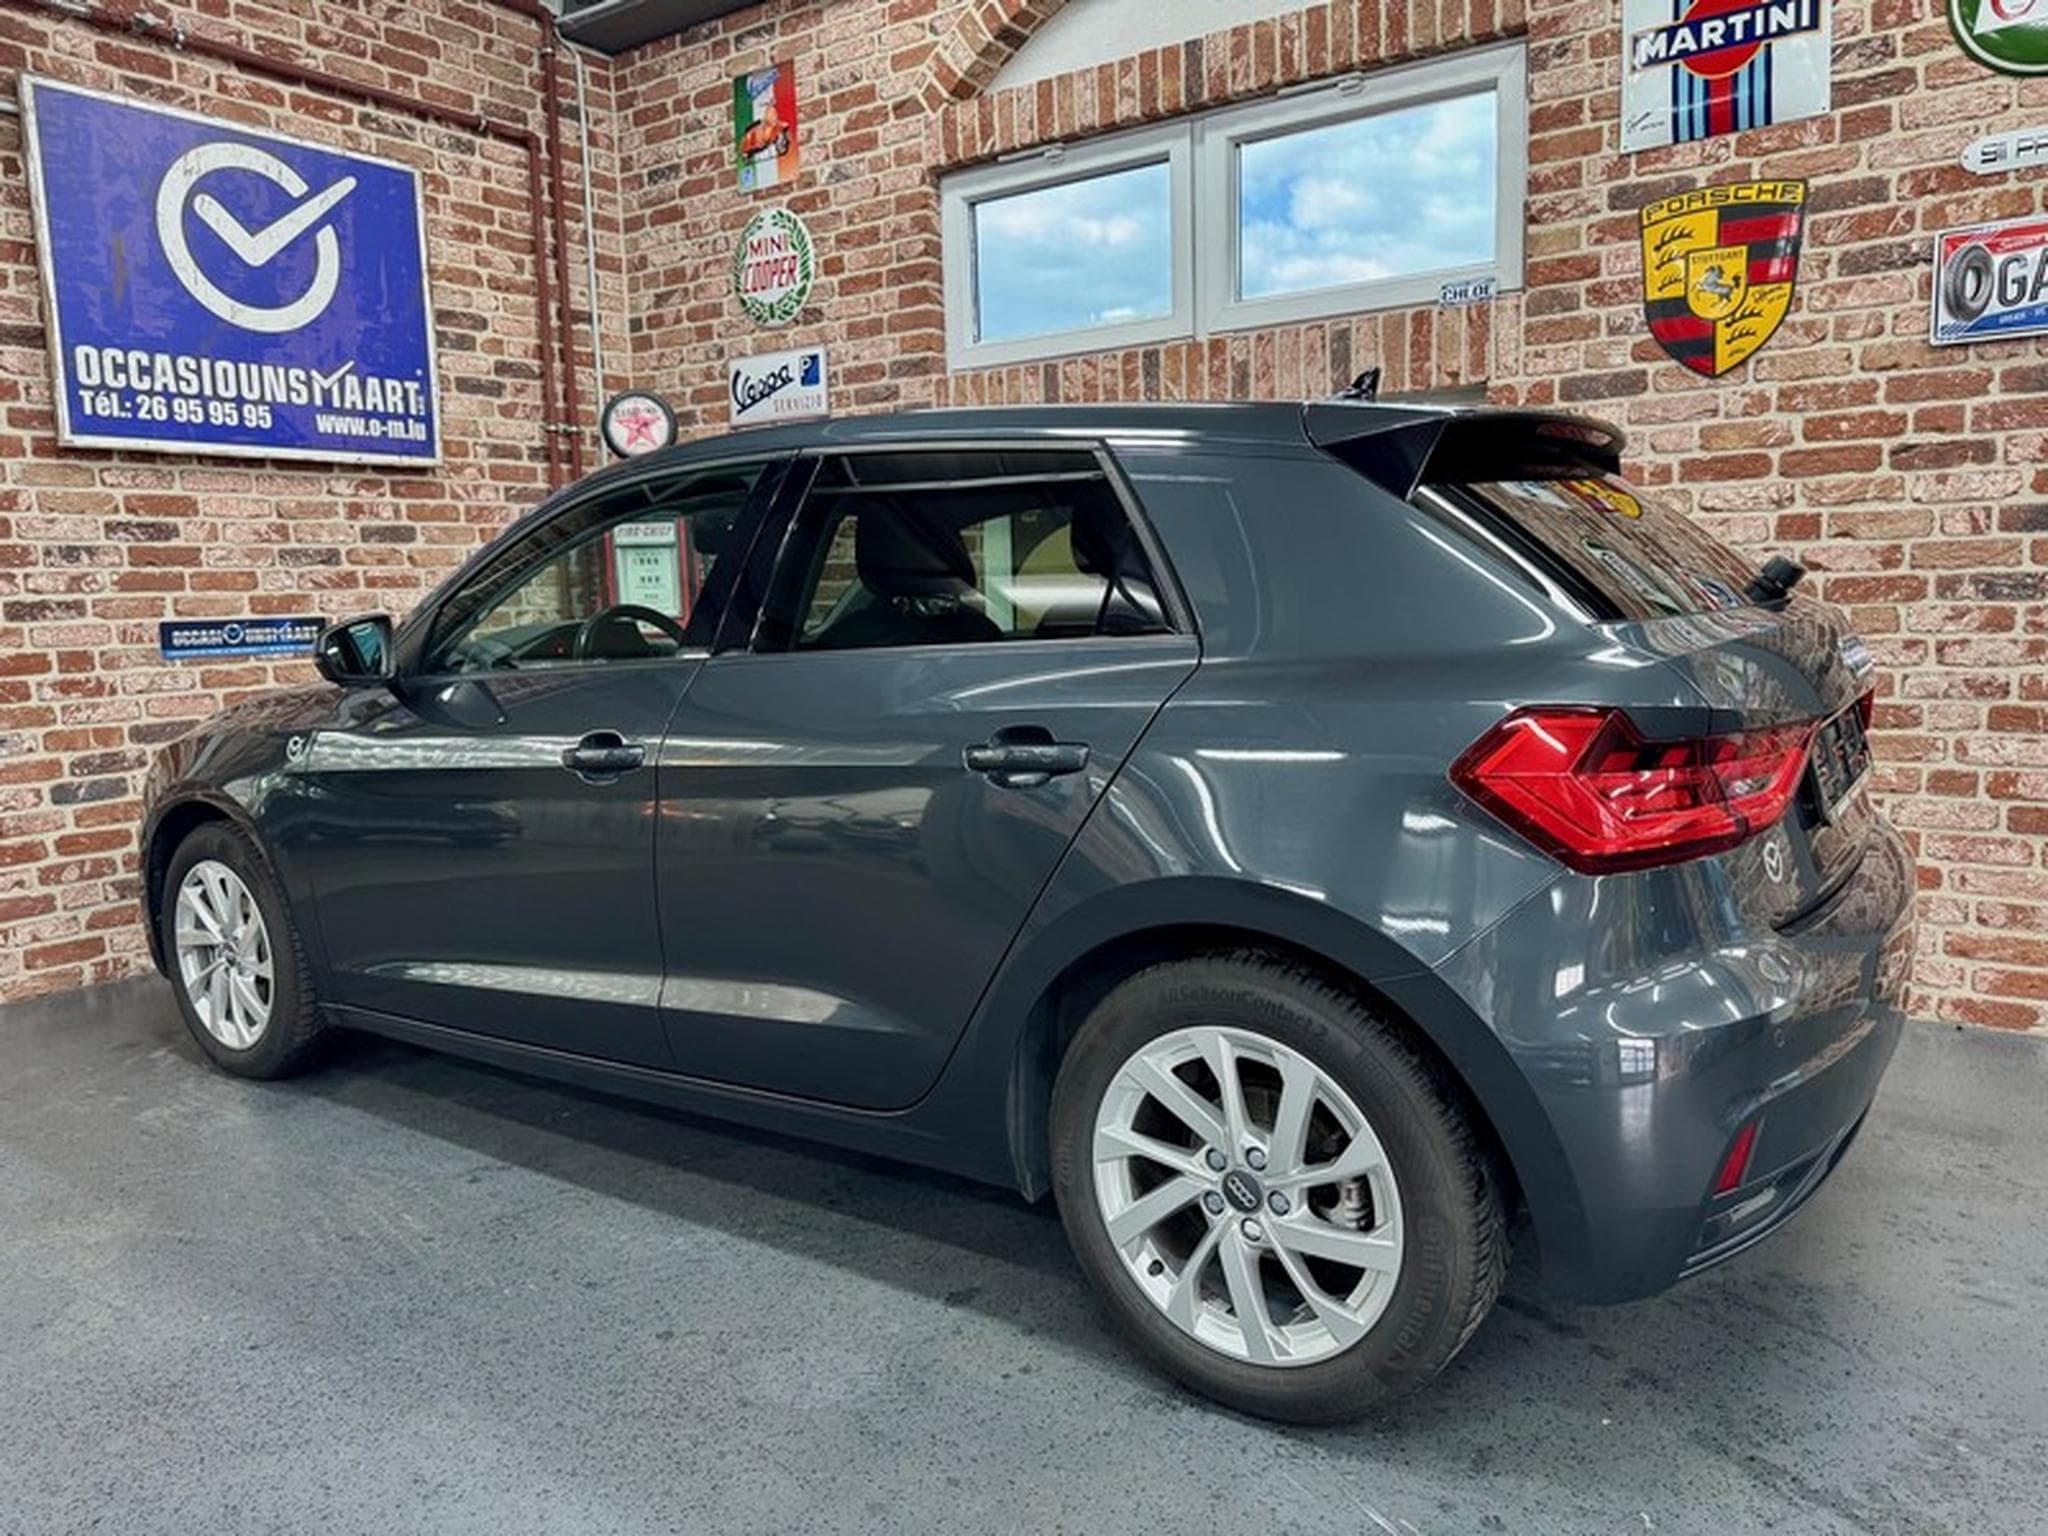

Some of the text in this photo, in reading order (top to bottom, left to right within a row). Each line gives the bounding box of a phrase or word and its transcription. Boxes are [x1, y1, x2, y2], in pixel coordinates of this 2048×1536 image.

[1635, 0, 1811, 65] MARTINI
[1646, 184, 1799, 221] PORSCHE
[749, 234, 789, 258] MINI
[744, 254, 798, 294] COOPER
[74, 345, 420, 415] OCCASIOUNSMAART
[732, 364, 795, 414] Vespa
[79, 389, 273, 430] Tél.: 26 95 95 95
[315, 413, 426, 441] www.o-m.lu
